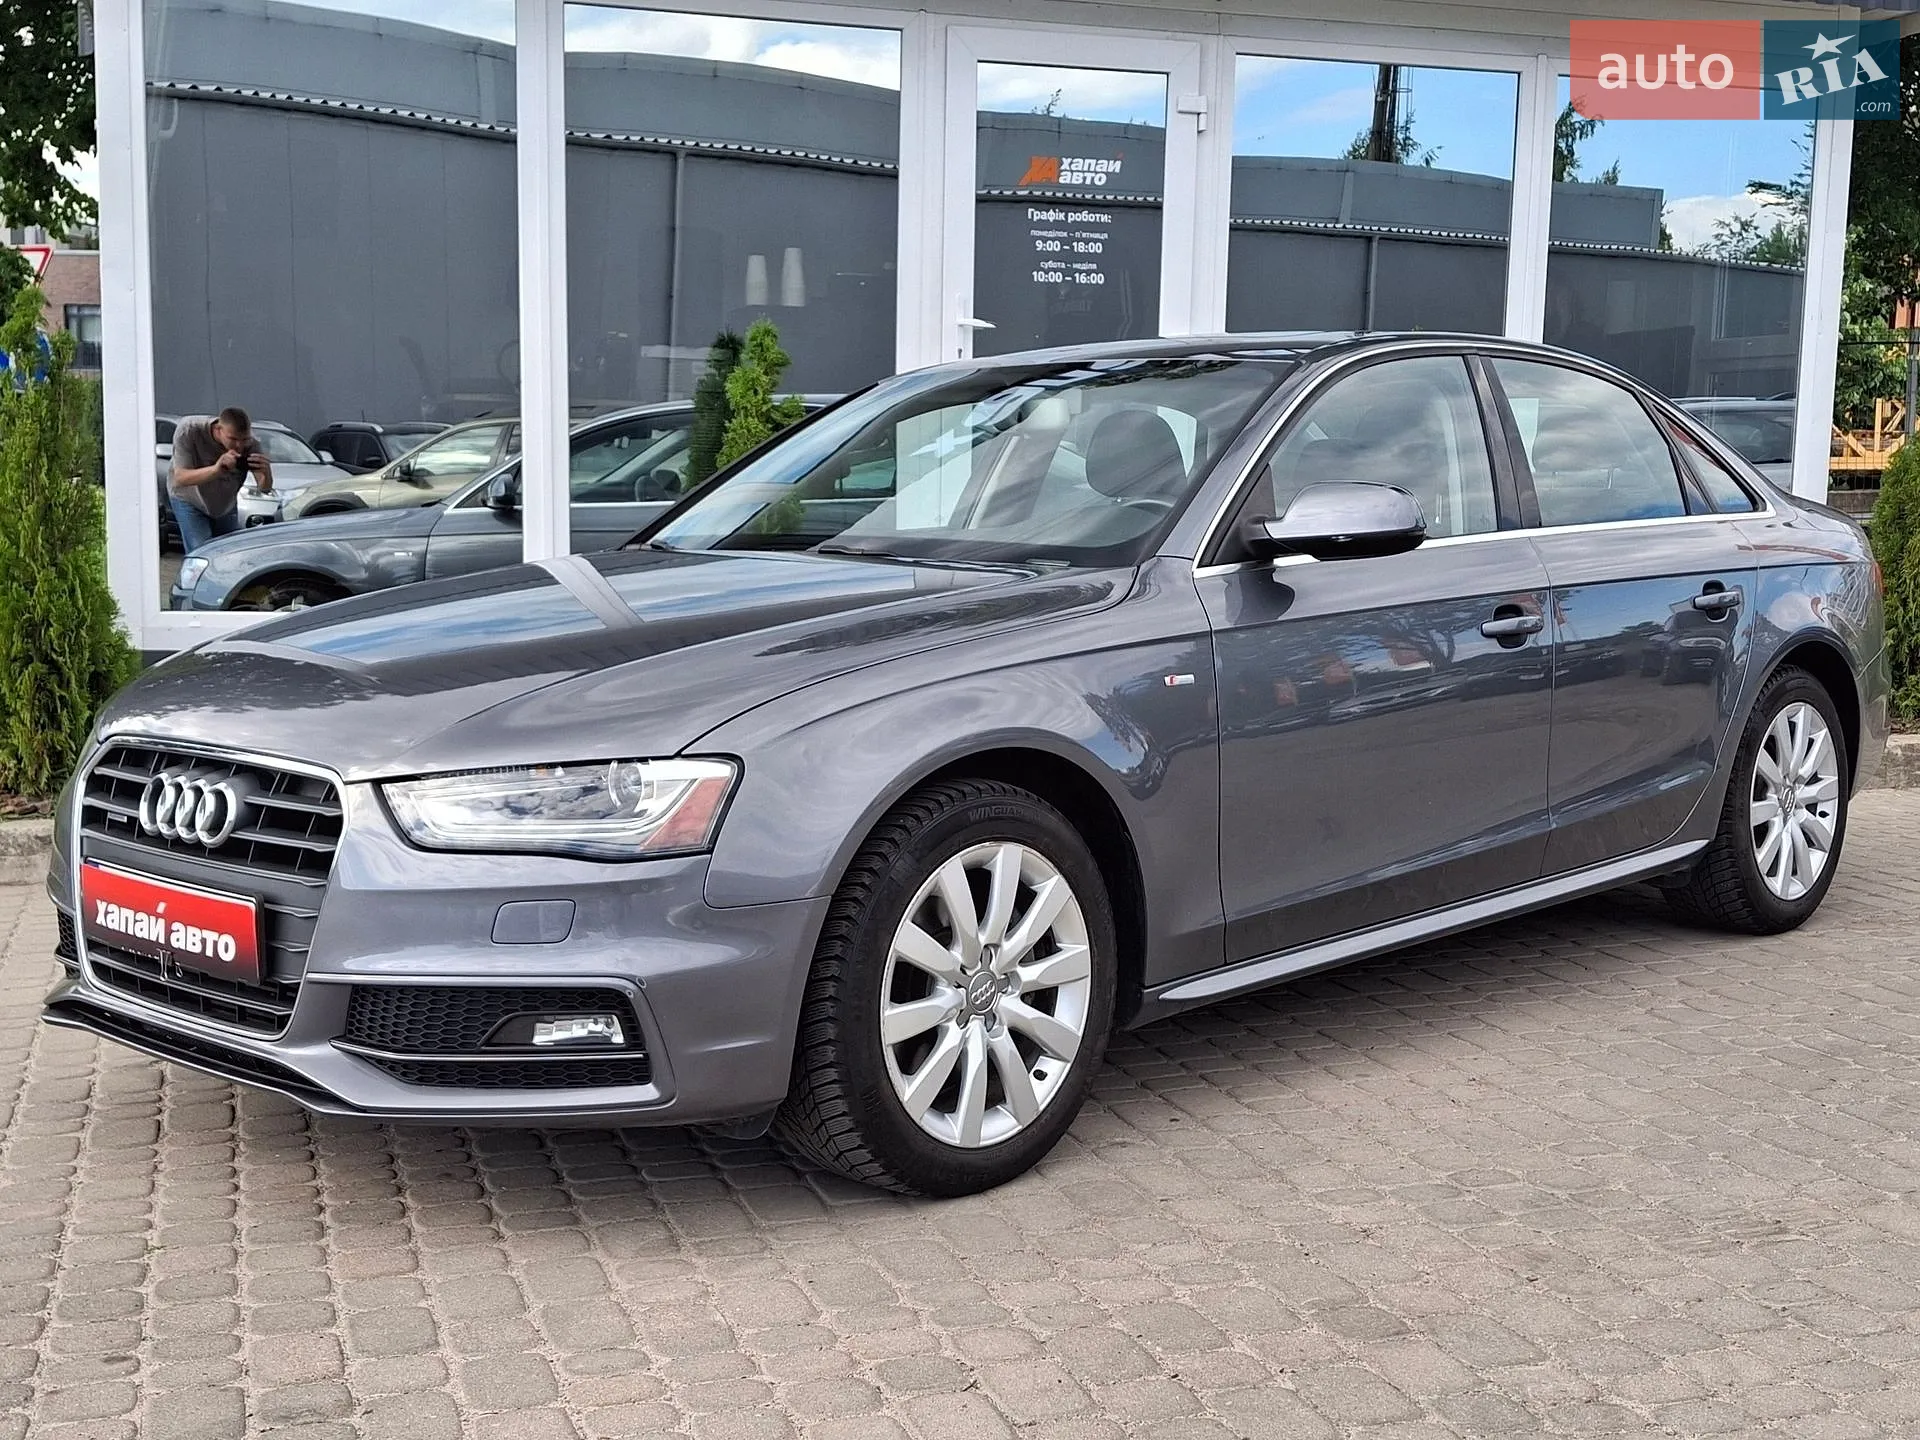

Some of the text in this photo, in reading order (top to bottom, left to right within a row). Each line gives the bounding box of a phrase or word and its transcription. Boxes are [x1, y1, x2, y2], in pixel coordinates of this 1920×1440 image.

[1059, 171, 1107, 185] авто
[1027, 208, 1112, 223] Графік роботи:
[1035, 240, 1061, 251] 9:00
[1072, 241, 1103, 253] 18:00
[1032, 271, 1063, 283] 10:00
[1074, 272, 1105, 285] 16:00
[170, 921, 237, 962] авто
